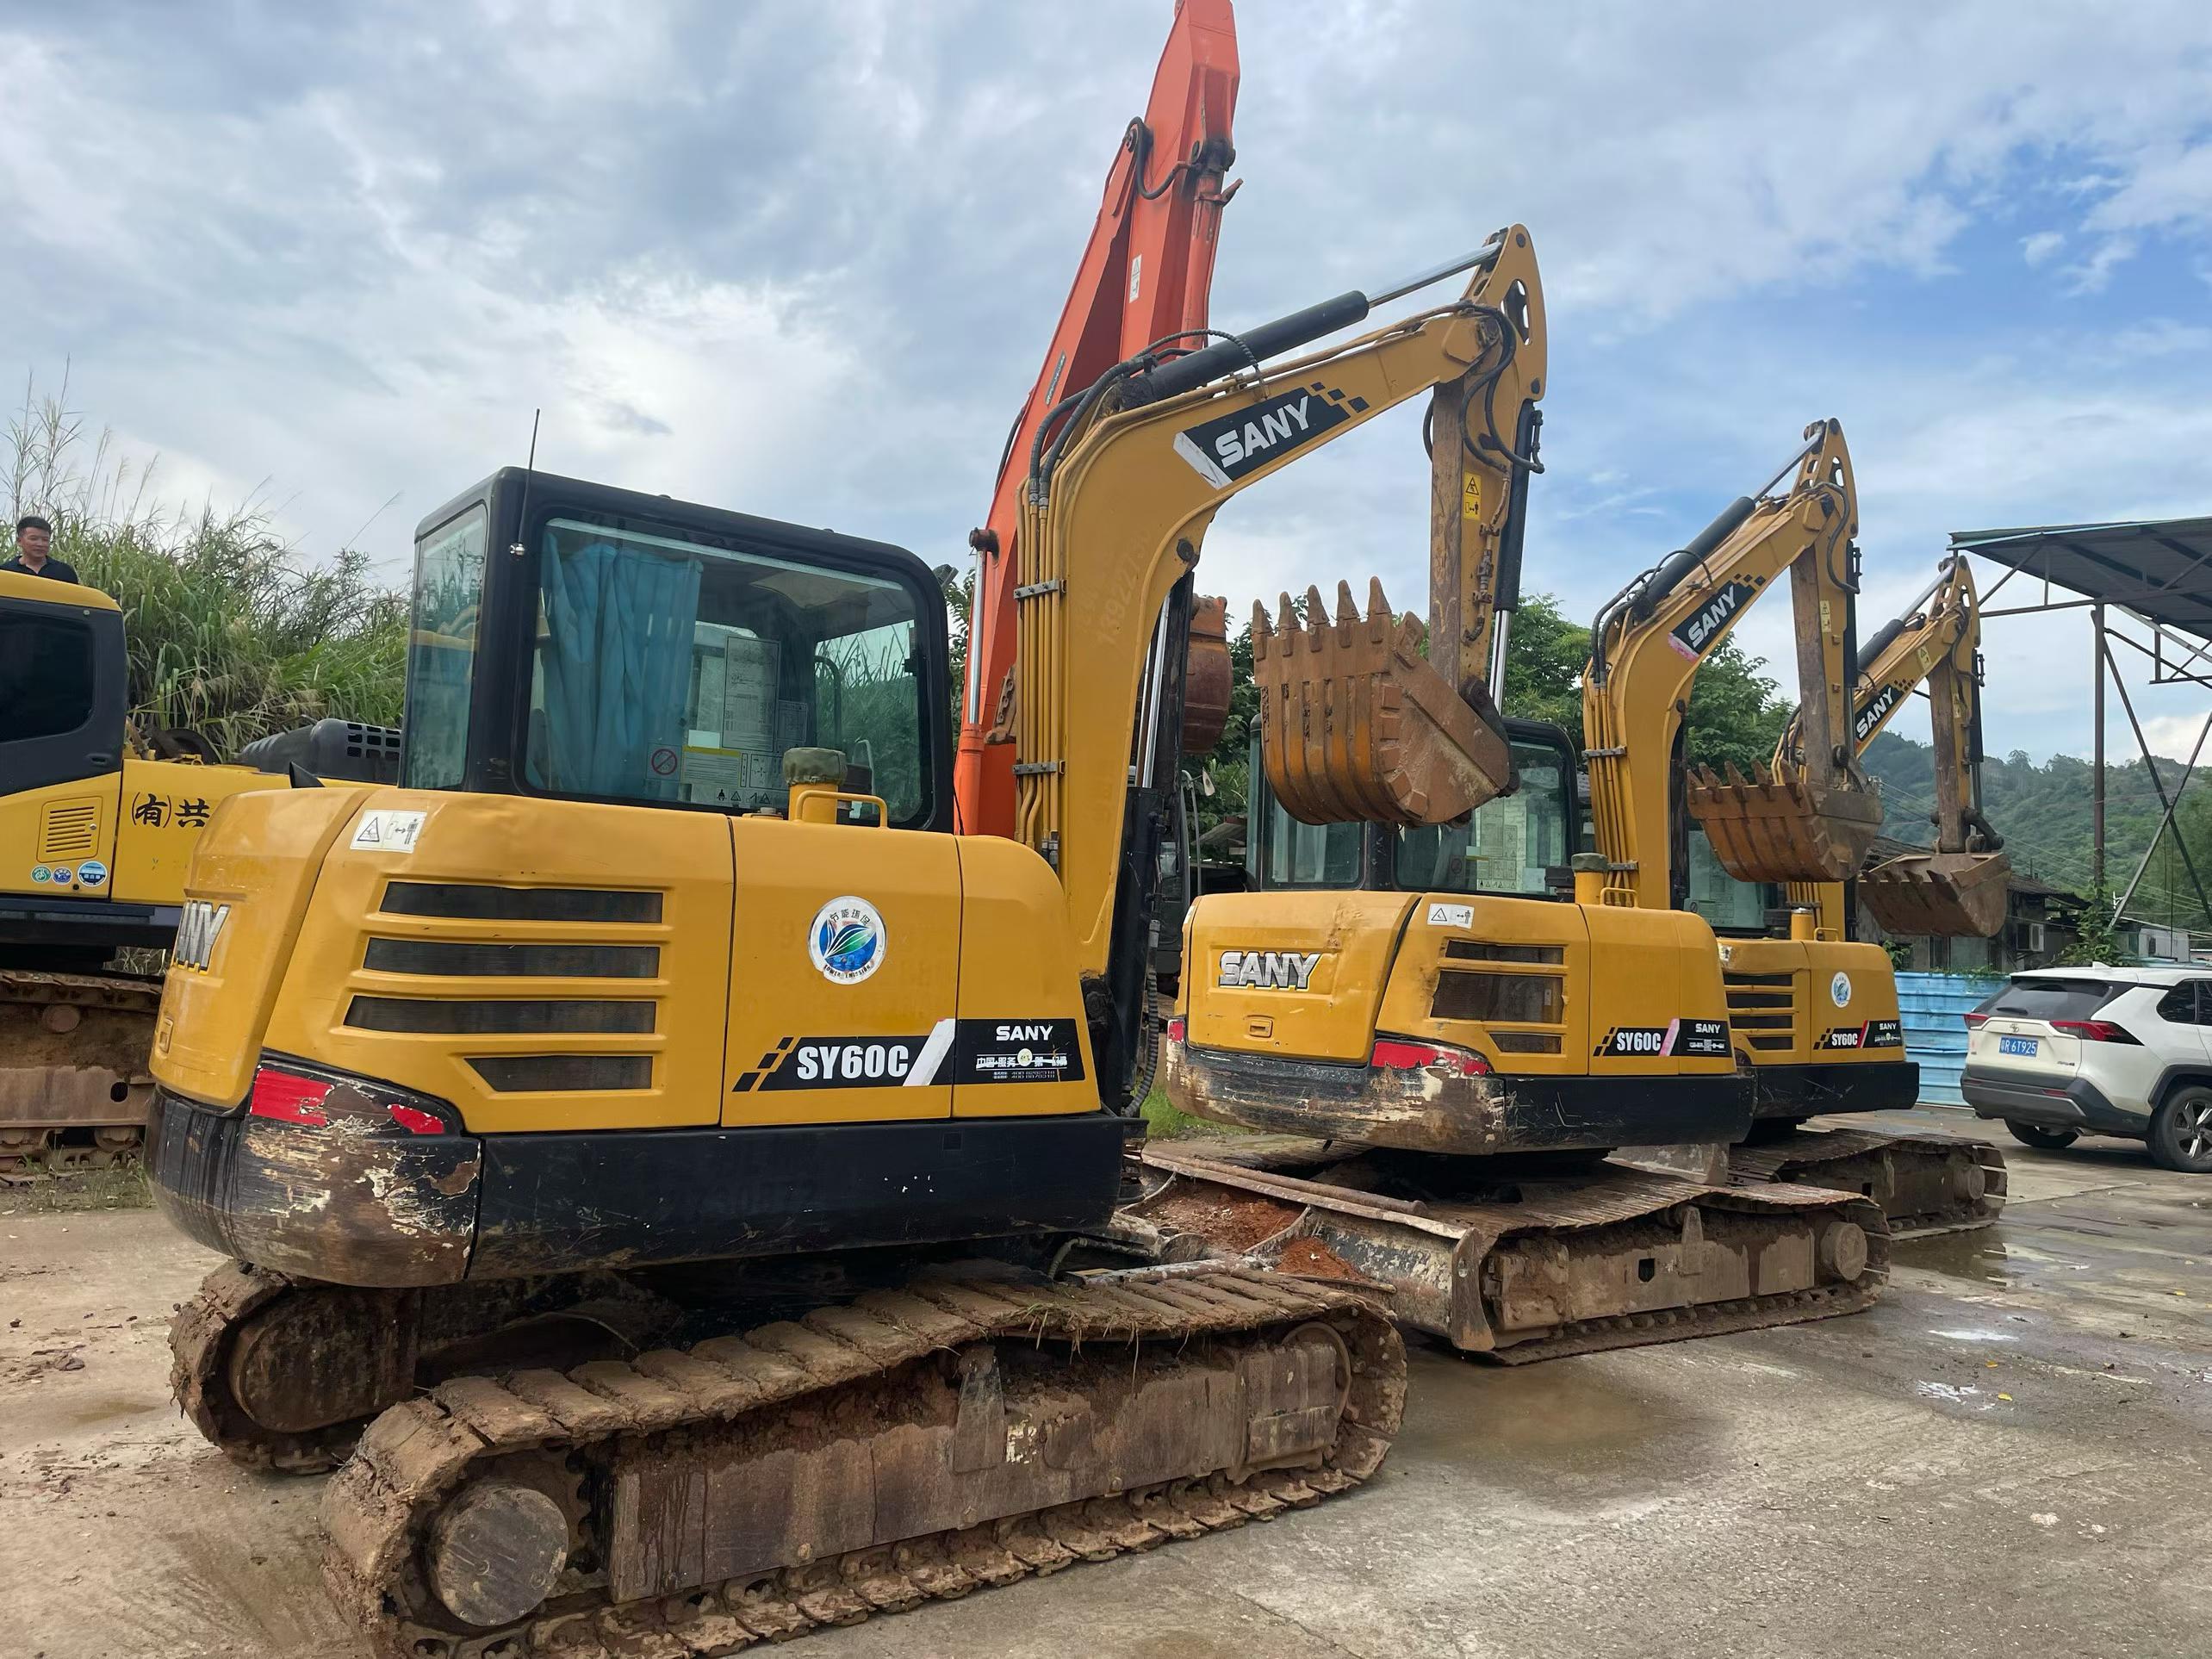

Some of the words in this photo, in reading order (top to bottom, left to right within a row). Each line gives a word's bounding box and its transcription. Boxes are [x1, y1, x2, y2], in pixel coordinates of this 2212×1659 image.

[1215, 395, 1309, 469] SANY
[1688, 585, 1736, 649] SANY
[1856, 687, 1893, 739] SANY
[1219, 951, 1322, 990] SANY
[995, 1025, 1053, 1041] SANY
[1695, 1023, 1720, 1034] SANY
[1831, 1033, 1858, 1047] SY60C
[1879, 1022, 1897, 1031] SANY
[1616, 1032, 1662, 1052] SY60C
[797, 1044, 910, 1080] SY60C
